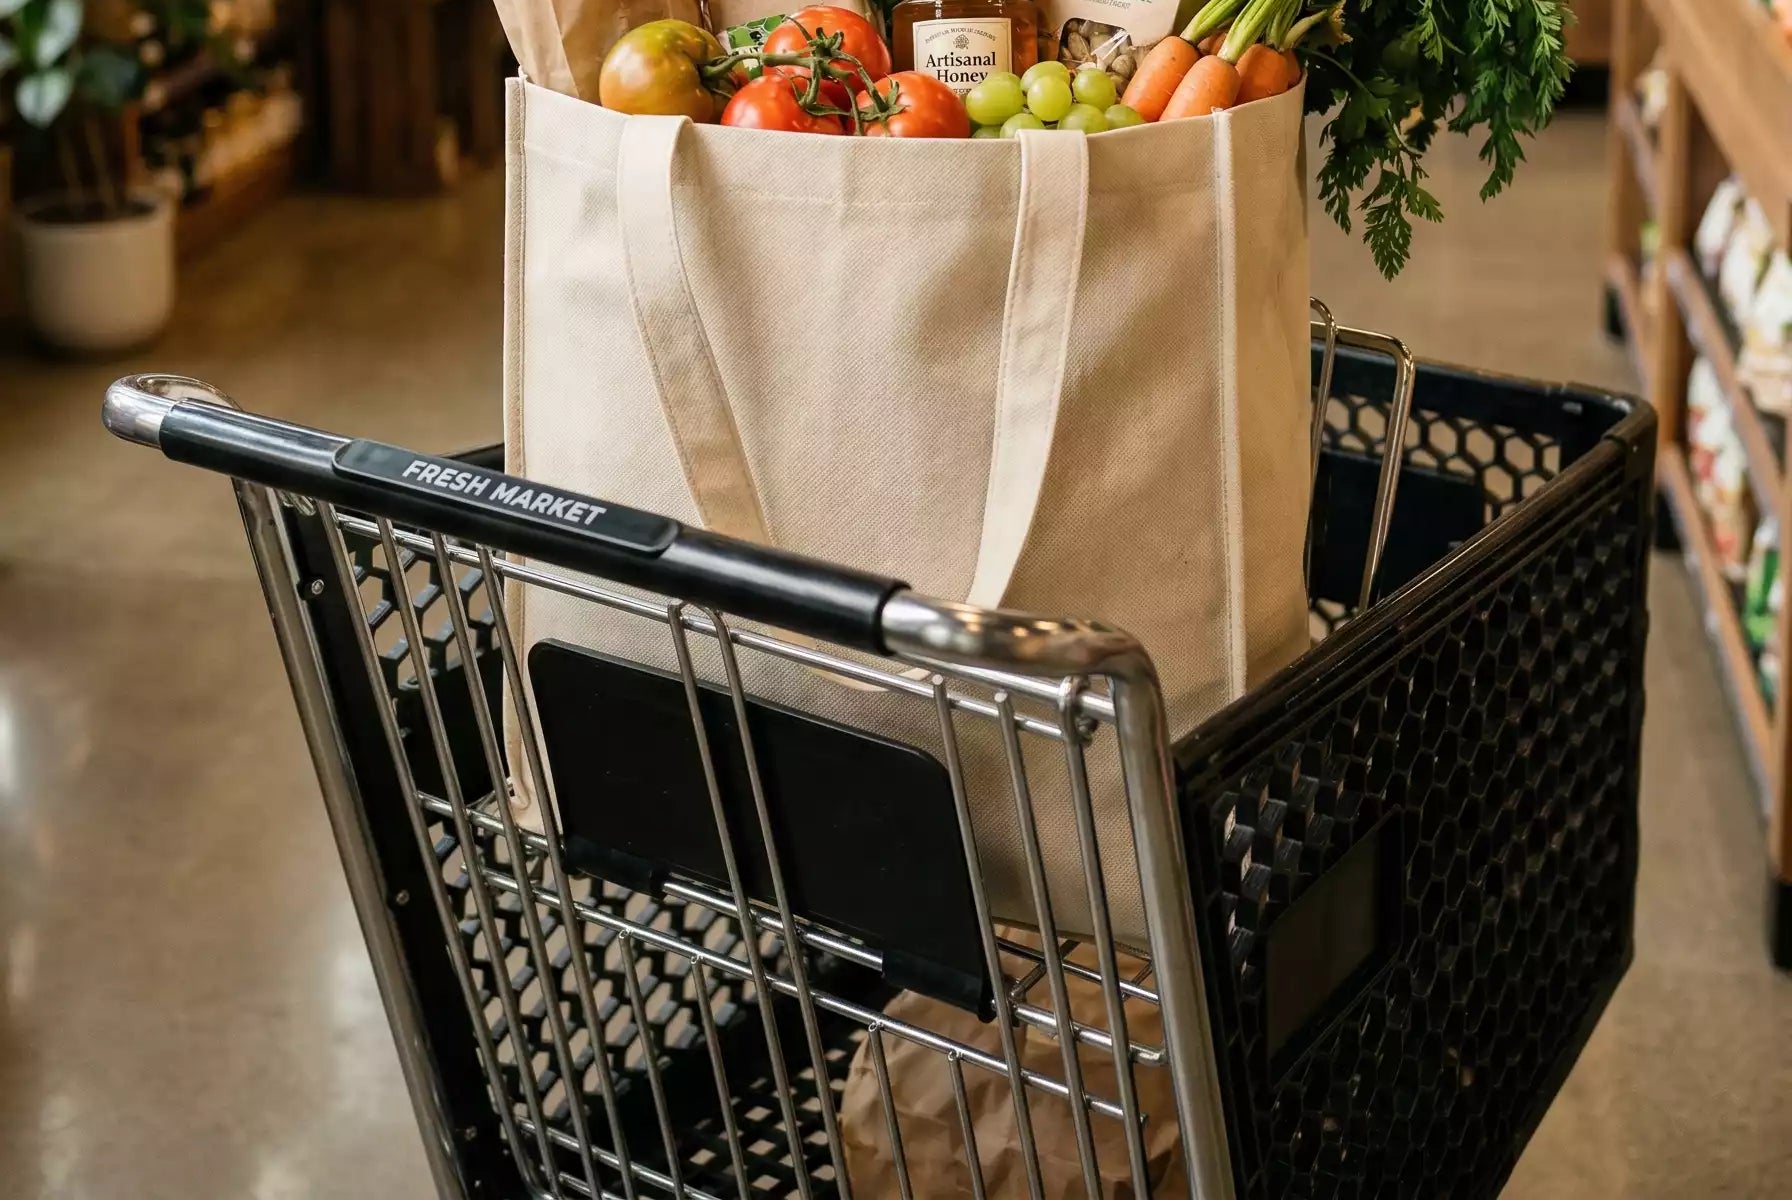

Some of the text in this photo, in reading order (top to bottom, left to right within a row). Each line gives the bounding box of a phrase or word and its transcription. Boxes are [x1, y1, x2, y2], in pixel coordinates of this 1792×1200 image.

[926, 52, 996, 67] Artisanal
[937, 69, 988, 84] Honey
[402, 460, 606, 525] FRESH MARKET
